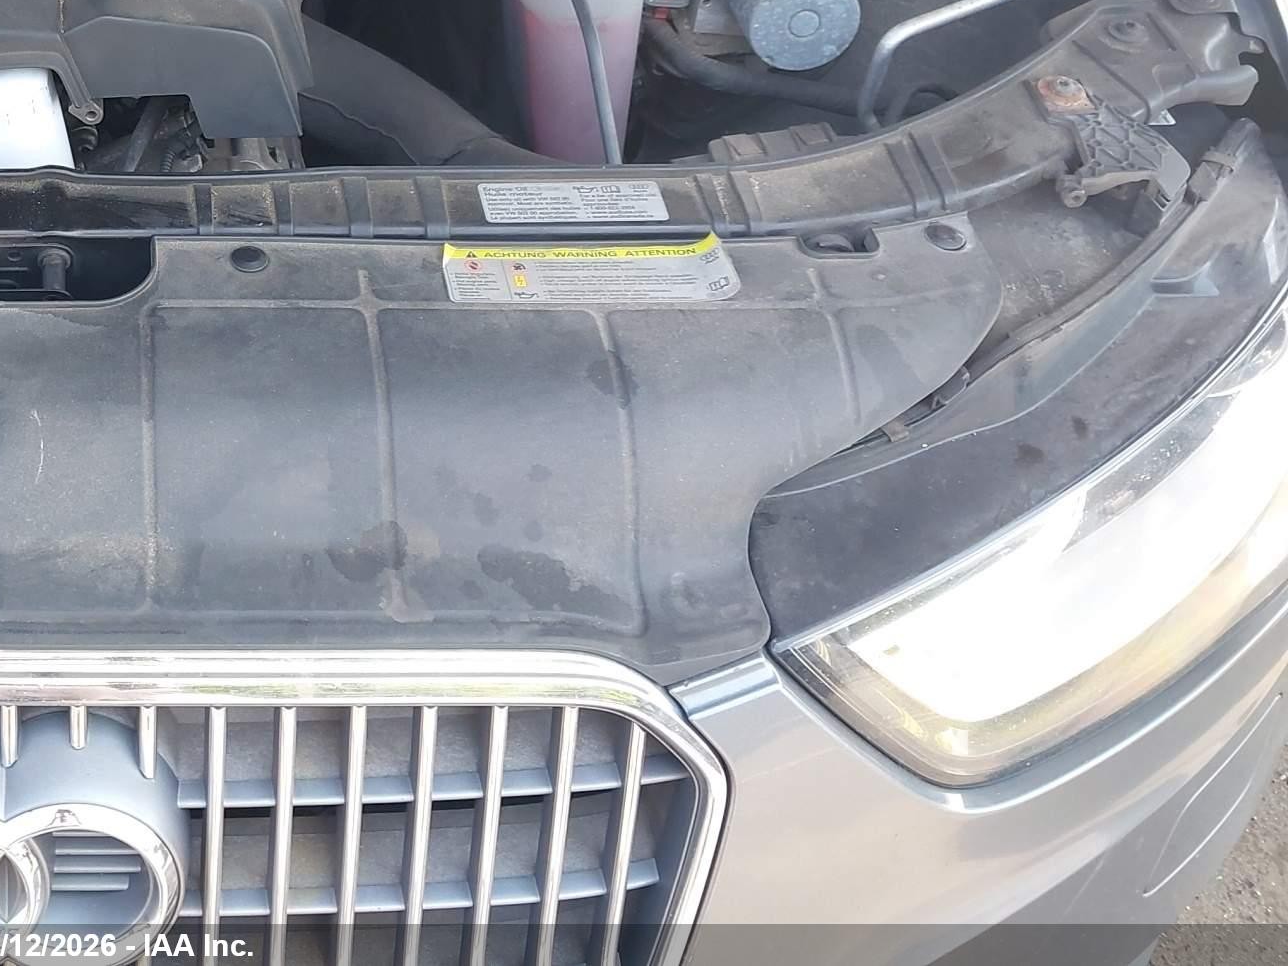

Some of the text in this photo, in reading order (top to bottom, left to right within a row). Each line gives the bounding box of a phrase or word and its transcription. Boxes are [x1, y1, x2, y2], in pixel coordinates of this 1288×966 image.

[483, 247, 696, 259] ACHTUNG WARNING ATTENTION
